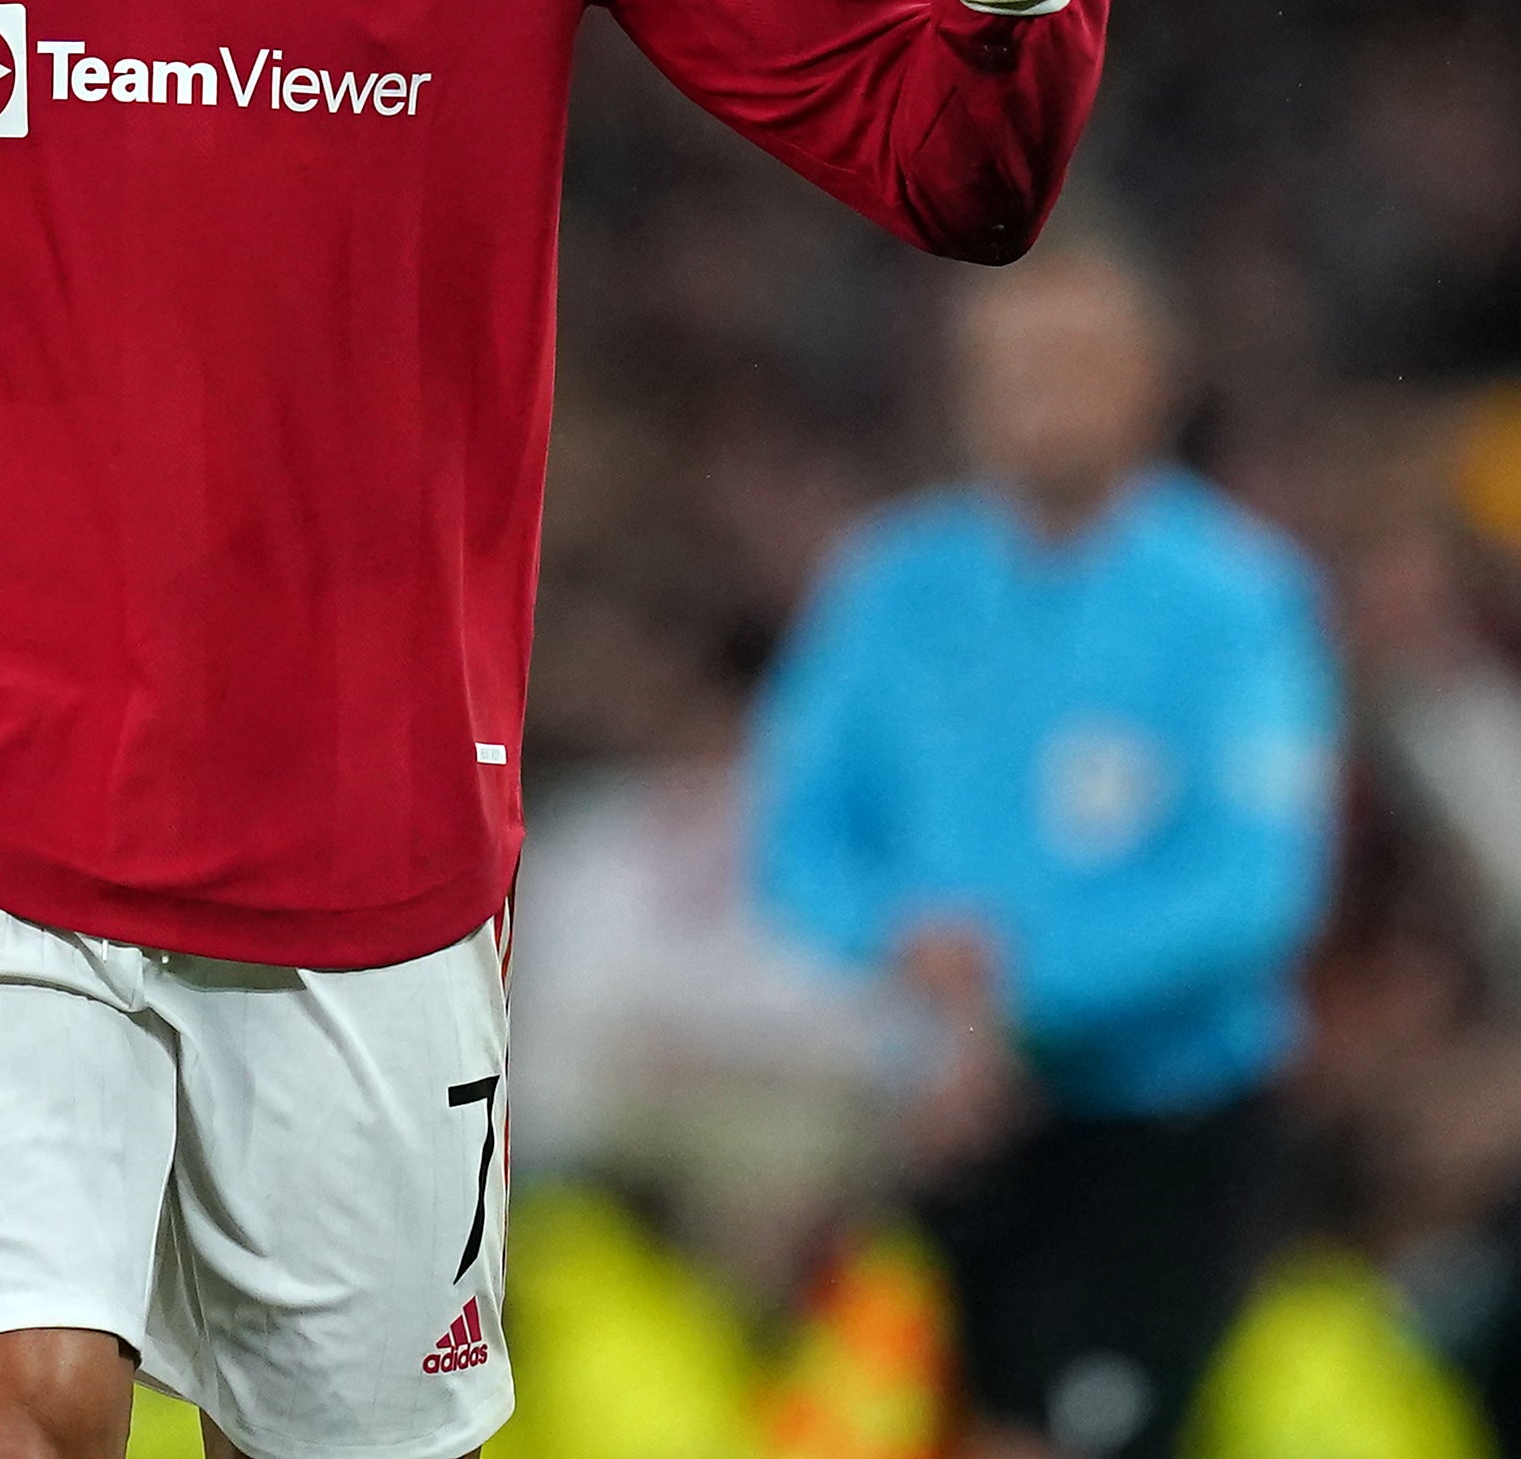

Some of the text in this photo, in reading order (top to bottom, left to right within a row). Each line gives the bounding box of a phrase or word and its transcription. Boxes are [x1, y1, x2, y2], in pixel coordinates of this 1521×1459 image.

[37, 40, 432, 116] TeamViewer
[447, 1074, 500, 1285] 7
[422, 1343, 488, 1374] adidas
